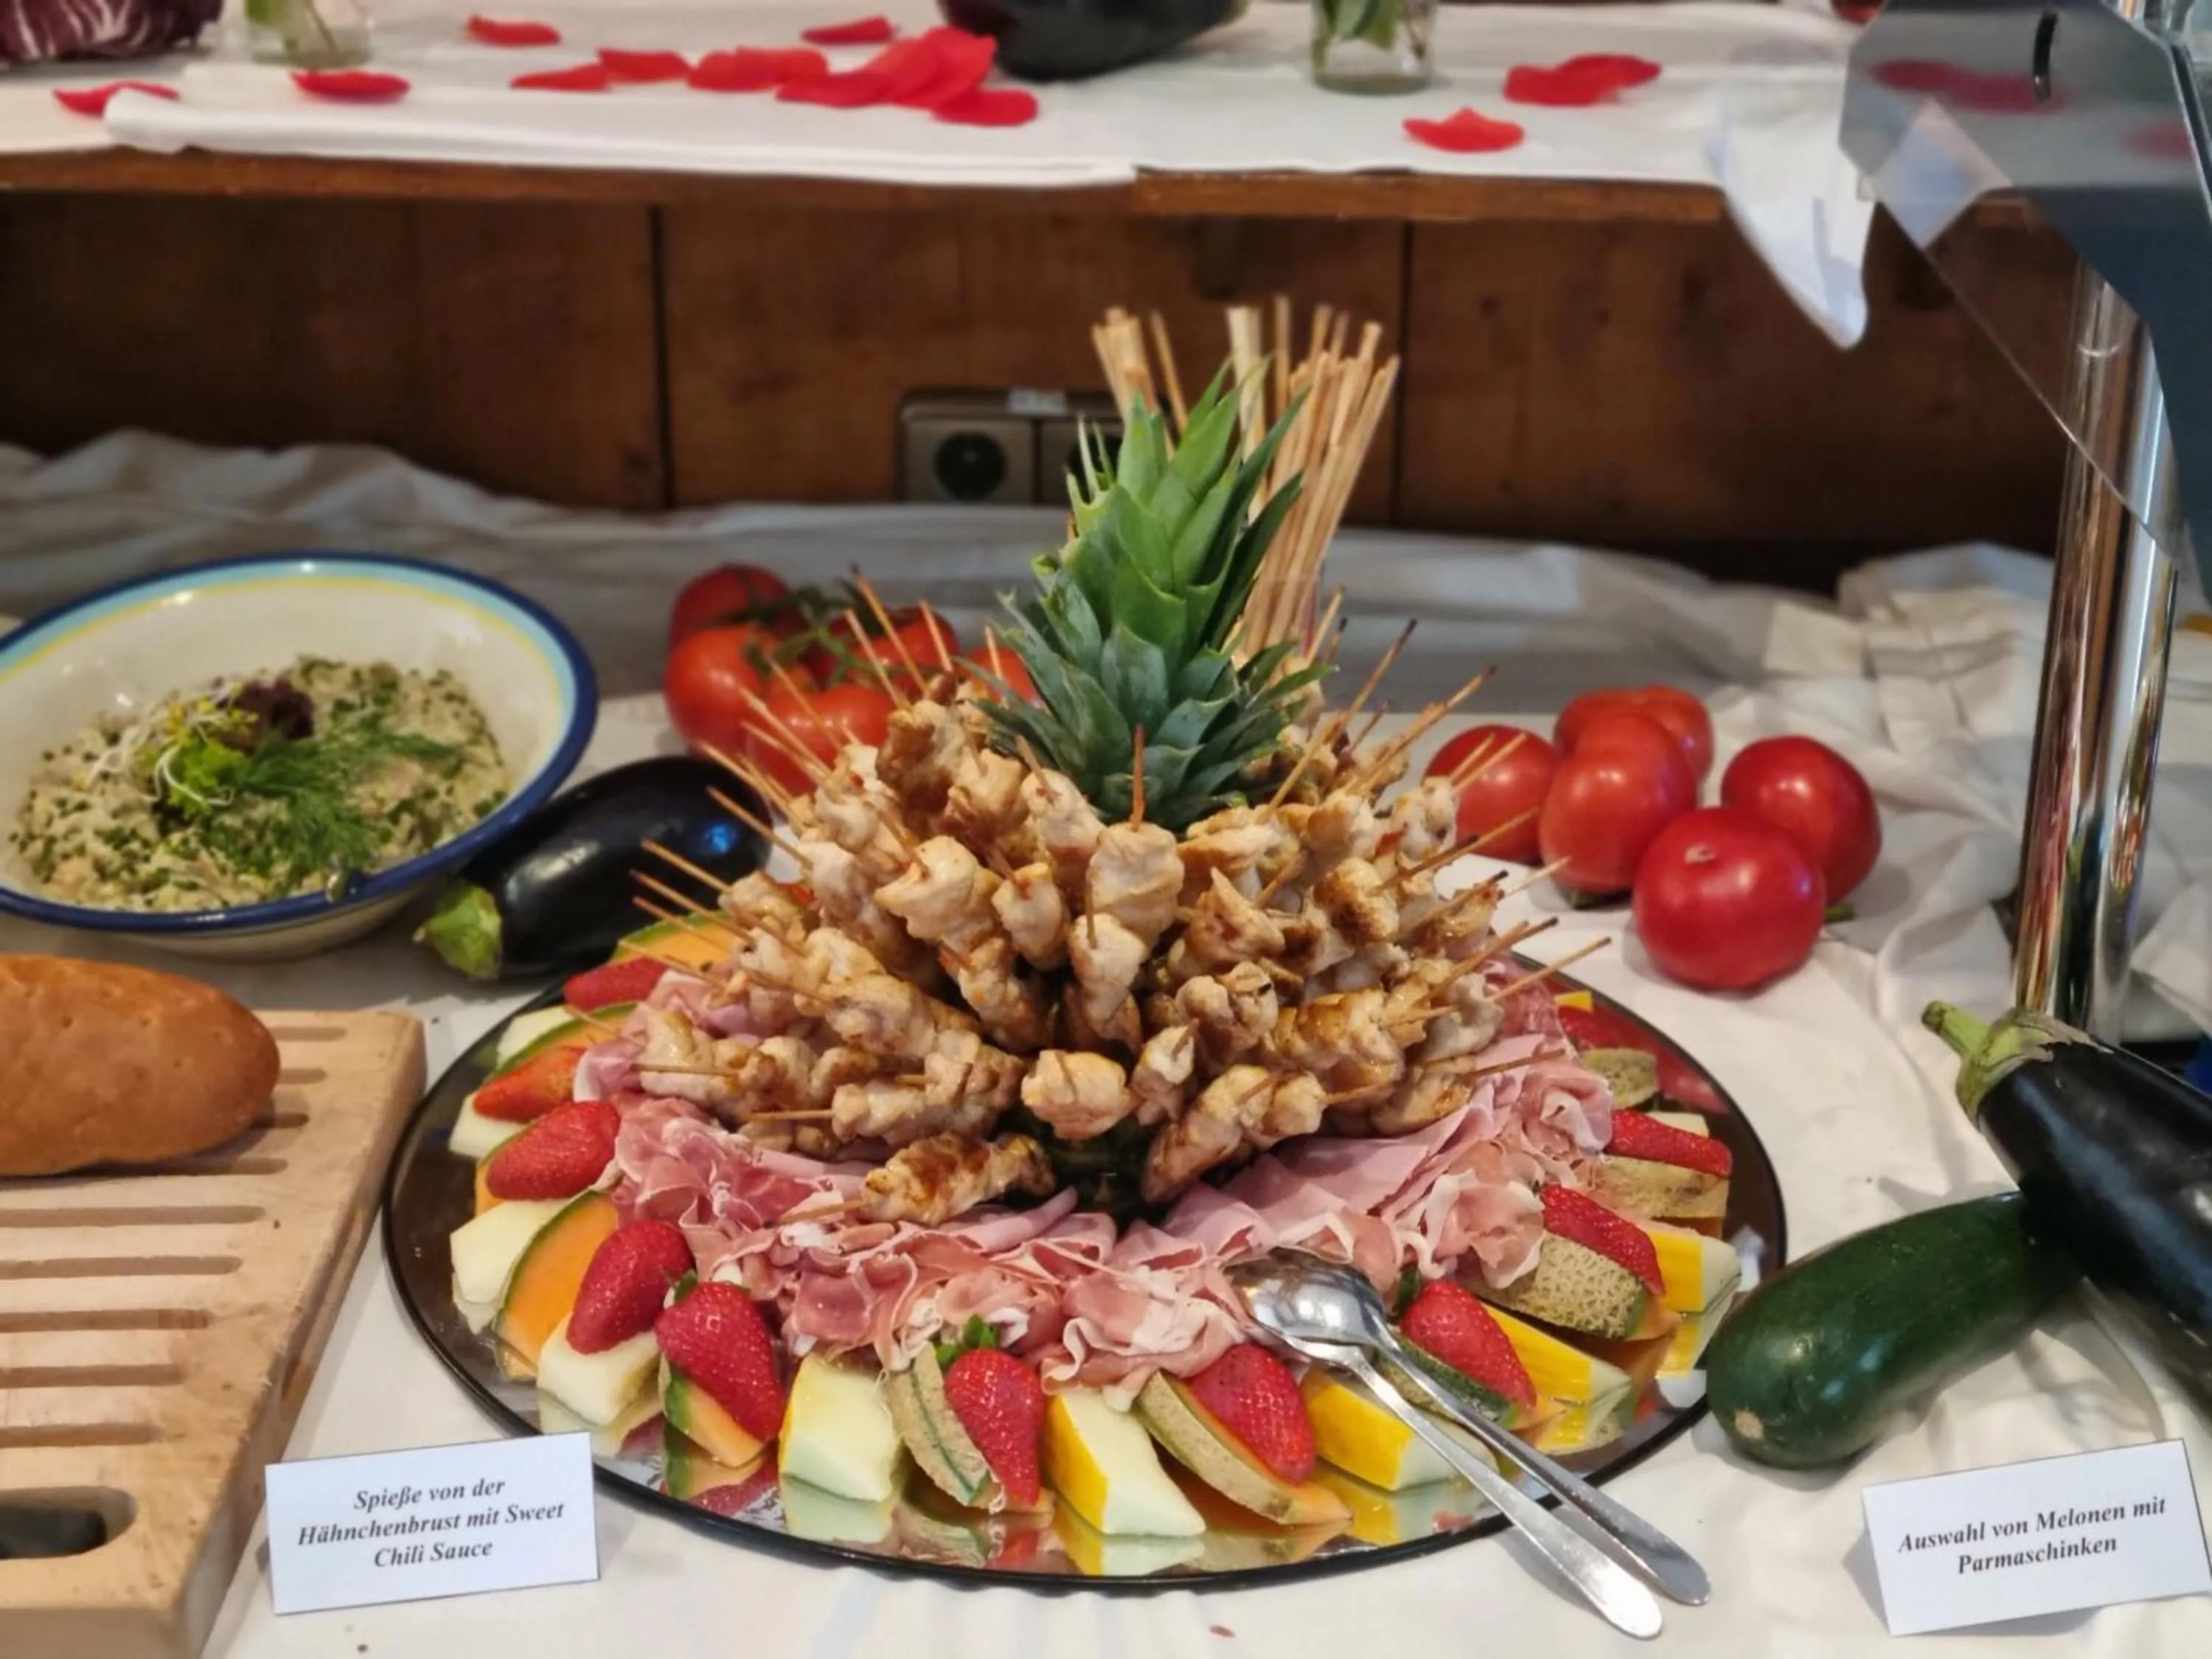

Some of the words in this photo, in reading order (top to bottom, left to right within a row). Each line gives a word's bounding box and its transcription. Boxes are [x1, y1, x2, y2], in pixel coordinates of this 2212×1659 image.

[353, 1486, 422, 1512] Spieße
[429, 1484, 465, 1502] von
[472, 1478, 505, 1498] der
[297, 1513, 460, 1545] Hähnchenbrust
[467, 1506, 499, 1528] mit
[504, 1502, 564, 1523] Sweet
[1898, 1521, 1986, 1553] Auswahl
[1992, 1520, 2028, 1539] von
[2036, 1506, 2125, 1533] Melonen
[2132, 1496, 2166, 1518] mit
[374, 1545, 425, 1568] Chili
[430, 1540, 493, 1562] Sauce
[1958, 1537, 2118, 1574] Parmaschinken
